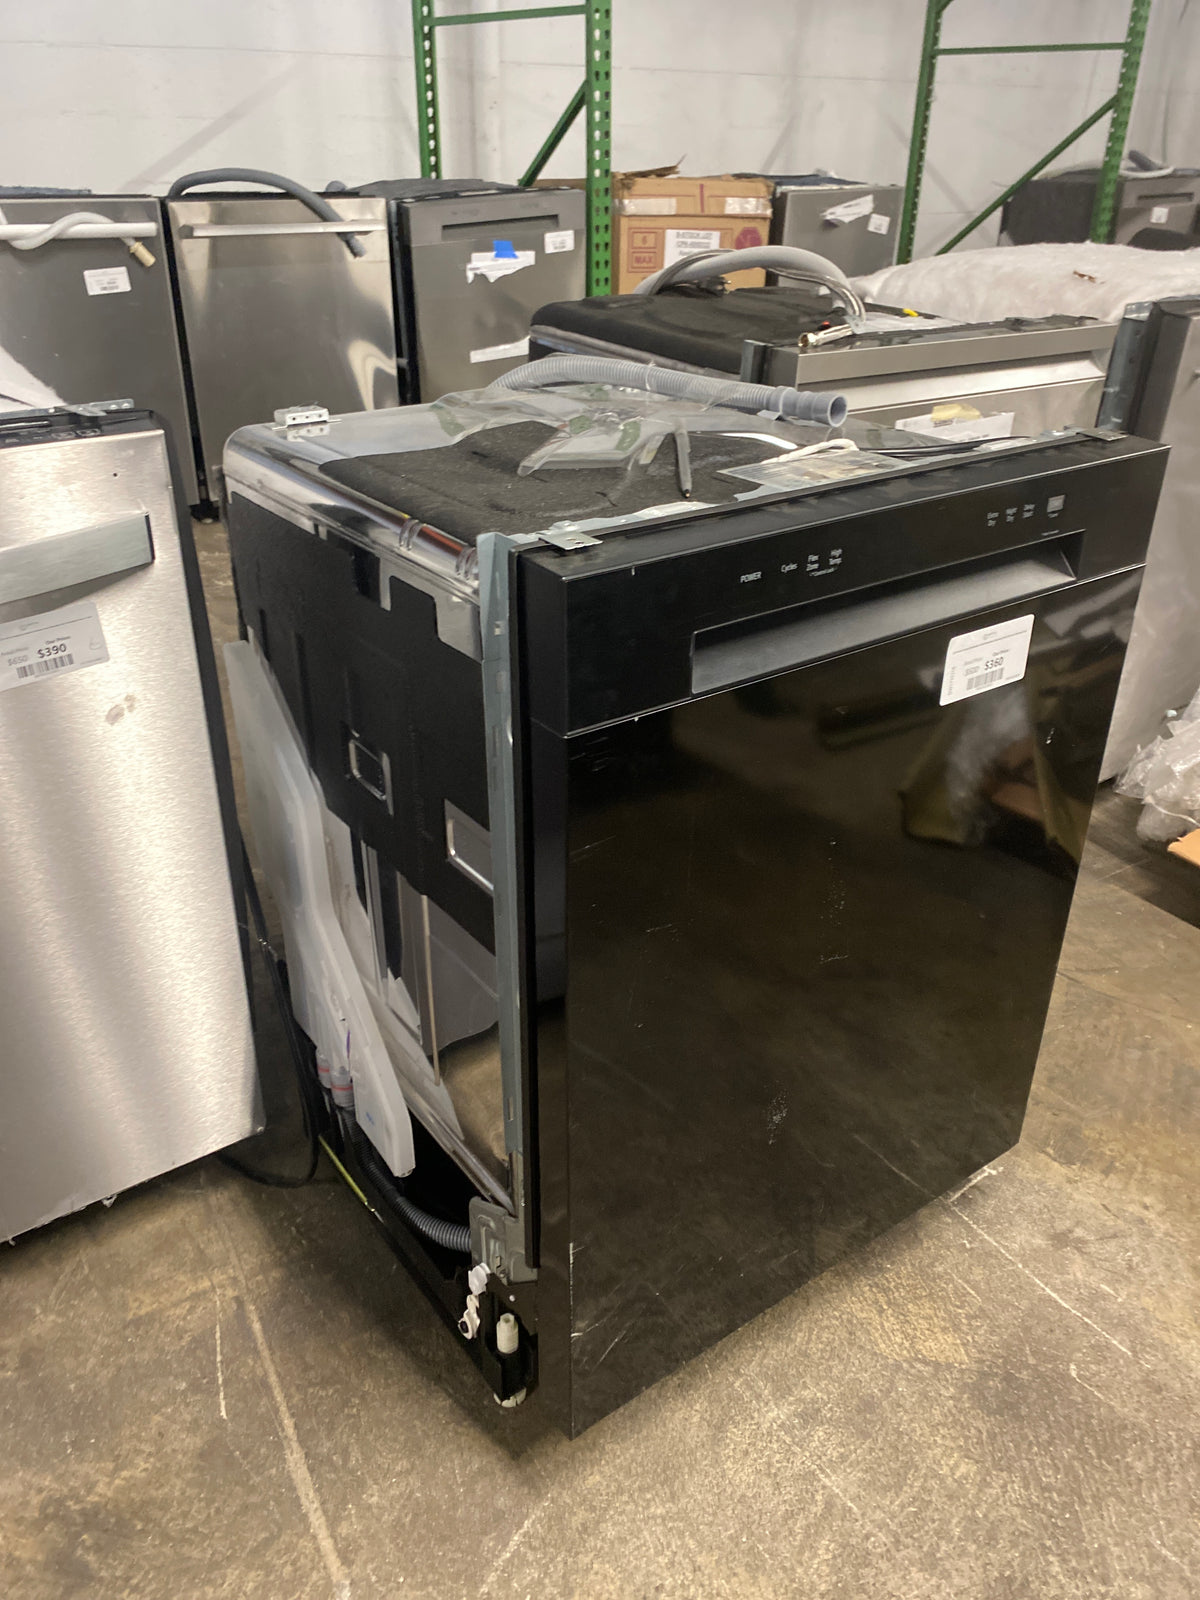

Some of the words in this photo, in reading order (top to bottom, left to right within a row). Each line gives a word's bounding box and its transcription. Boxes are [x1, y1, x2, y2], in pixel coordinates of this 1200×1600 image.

[635, 256, 653, 265] MAX
[781, 563, 798, 573] Cycles
[740, 572, 762, 583] POWER
[37, 643, 67, 659] $390
[984, 656, 1004, 671] $360
